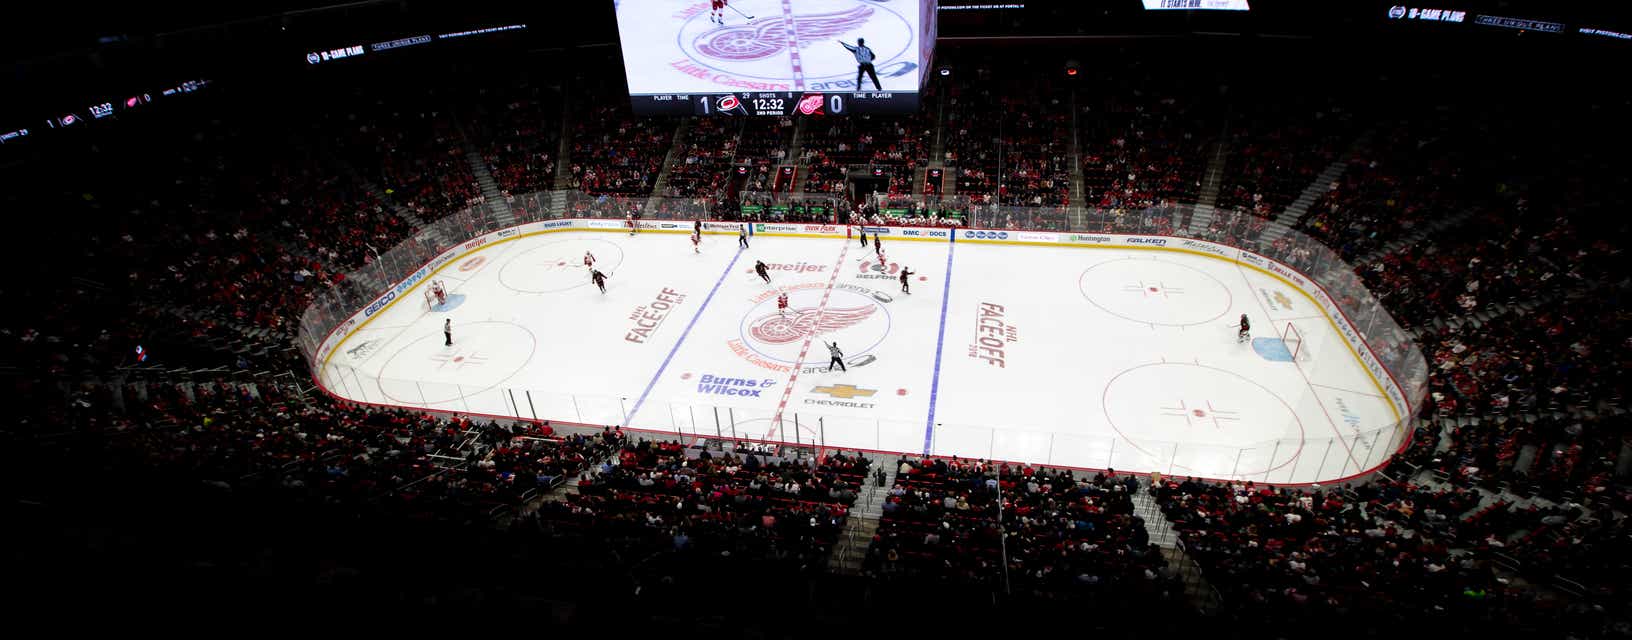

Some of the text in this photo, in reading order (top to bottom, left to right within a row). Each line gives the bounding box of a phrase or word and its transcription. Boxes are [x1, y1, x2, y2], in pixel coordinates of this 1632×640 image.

[345, 45, 364, 56] PLANS
[90, 102, 113, 116] 12:32
[700, 96, 709, 114] 1
[752, 99, 785, 110] 12:32
[830, 95, 842, 113] 0
[465, 238, 487, 250] meijer
[1077, 234, 1112, 243] Huntington
[1127, 237, 1167, 245] FALKEN
[767, 262, 828, 274] meijer
[364, 291, 396, 317] GEICO
[629, 305, 647, 321] NHL
[1006, 325, 1017, 342] NHL
[700, 374, 777, 389] Burns &
[697, 384, 762, 398] Wilcox
[804, 398, 876, 410] CHEVROLET
